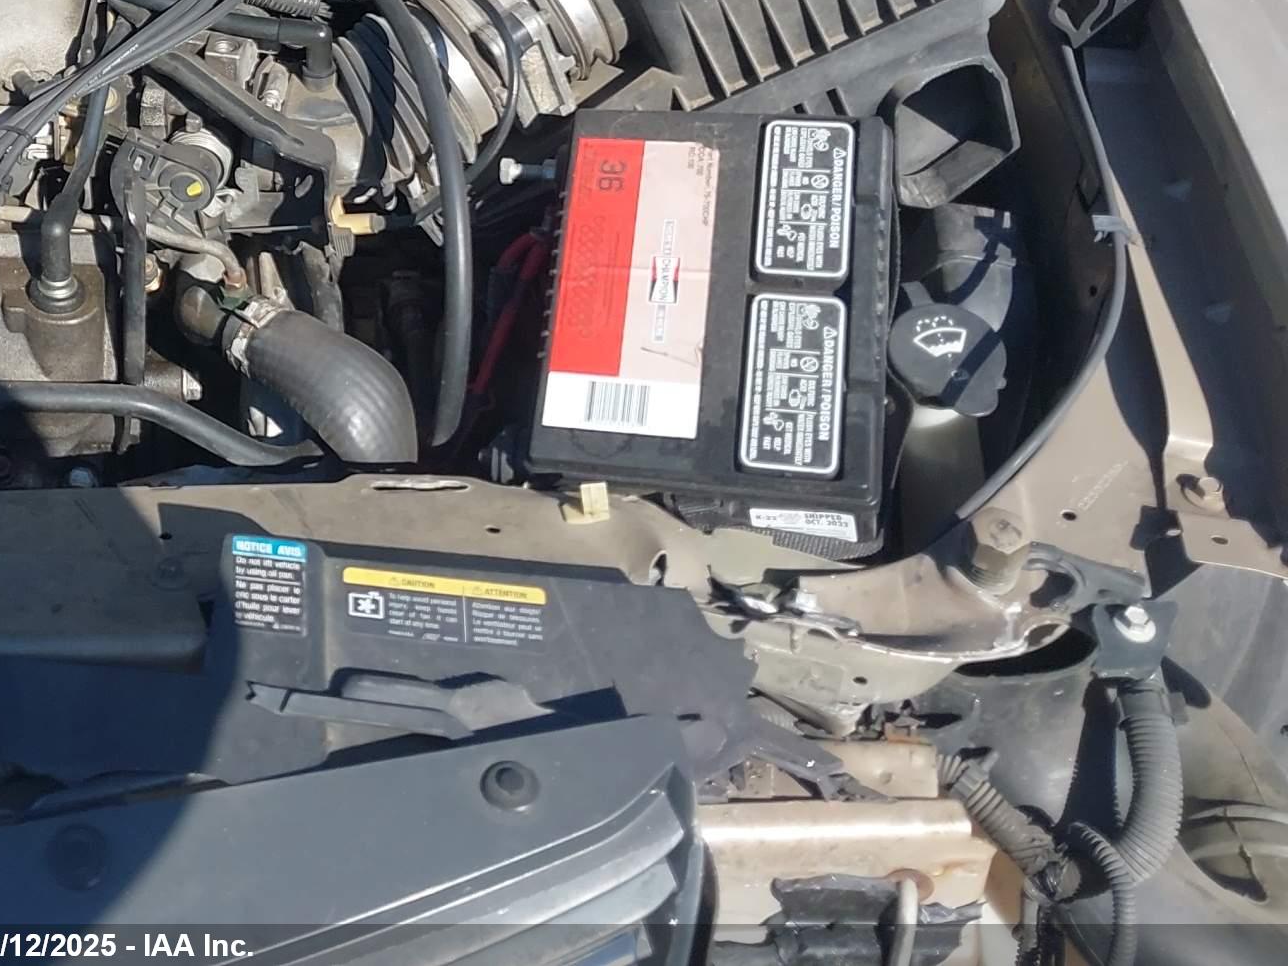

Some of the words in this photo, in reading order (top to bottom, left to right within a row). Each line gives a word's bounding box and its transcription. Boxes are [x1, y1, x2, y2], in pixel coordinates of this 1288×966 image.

[598, 160, 628, 192] 36
[658, 258, 672, 301] CHAMPION
[236, 540, 272, 554] NOTICE
[277, 545, 302, 557] AVIS
[236, 556, 246, 564] Do
[248, 557, 261, 566] not
[263, 559, 272, 567] lift
[275, 561, 300, 570] vehicle
[235, 566, 244, 574] by
[246, 567, 267, 578] using
[267, 569, 277, 577] oil
[236, 580, 246, 588] Ne
[250, 583, 264, 591] pas
[267, 584, 290, 593] placer
[401, 579, 435, 589] CAUTION
[484, 588, 528, 599] ATTENTION
[269, 594, 277, 602] le
[279, 595, 300, 604] carter
[262, 604, 280, 613] pour
